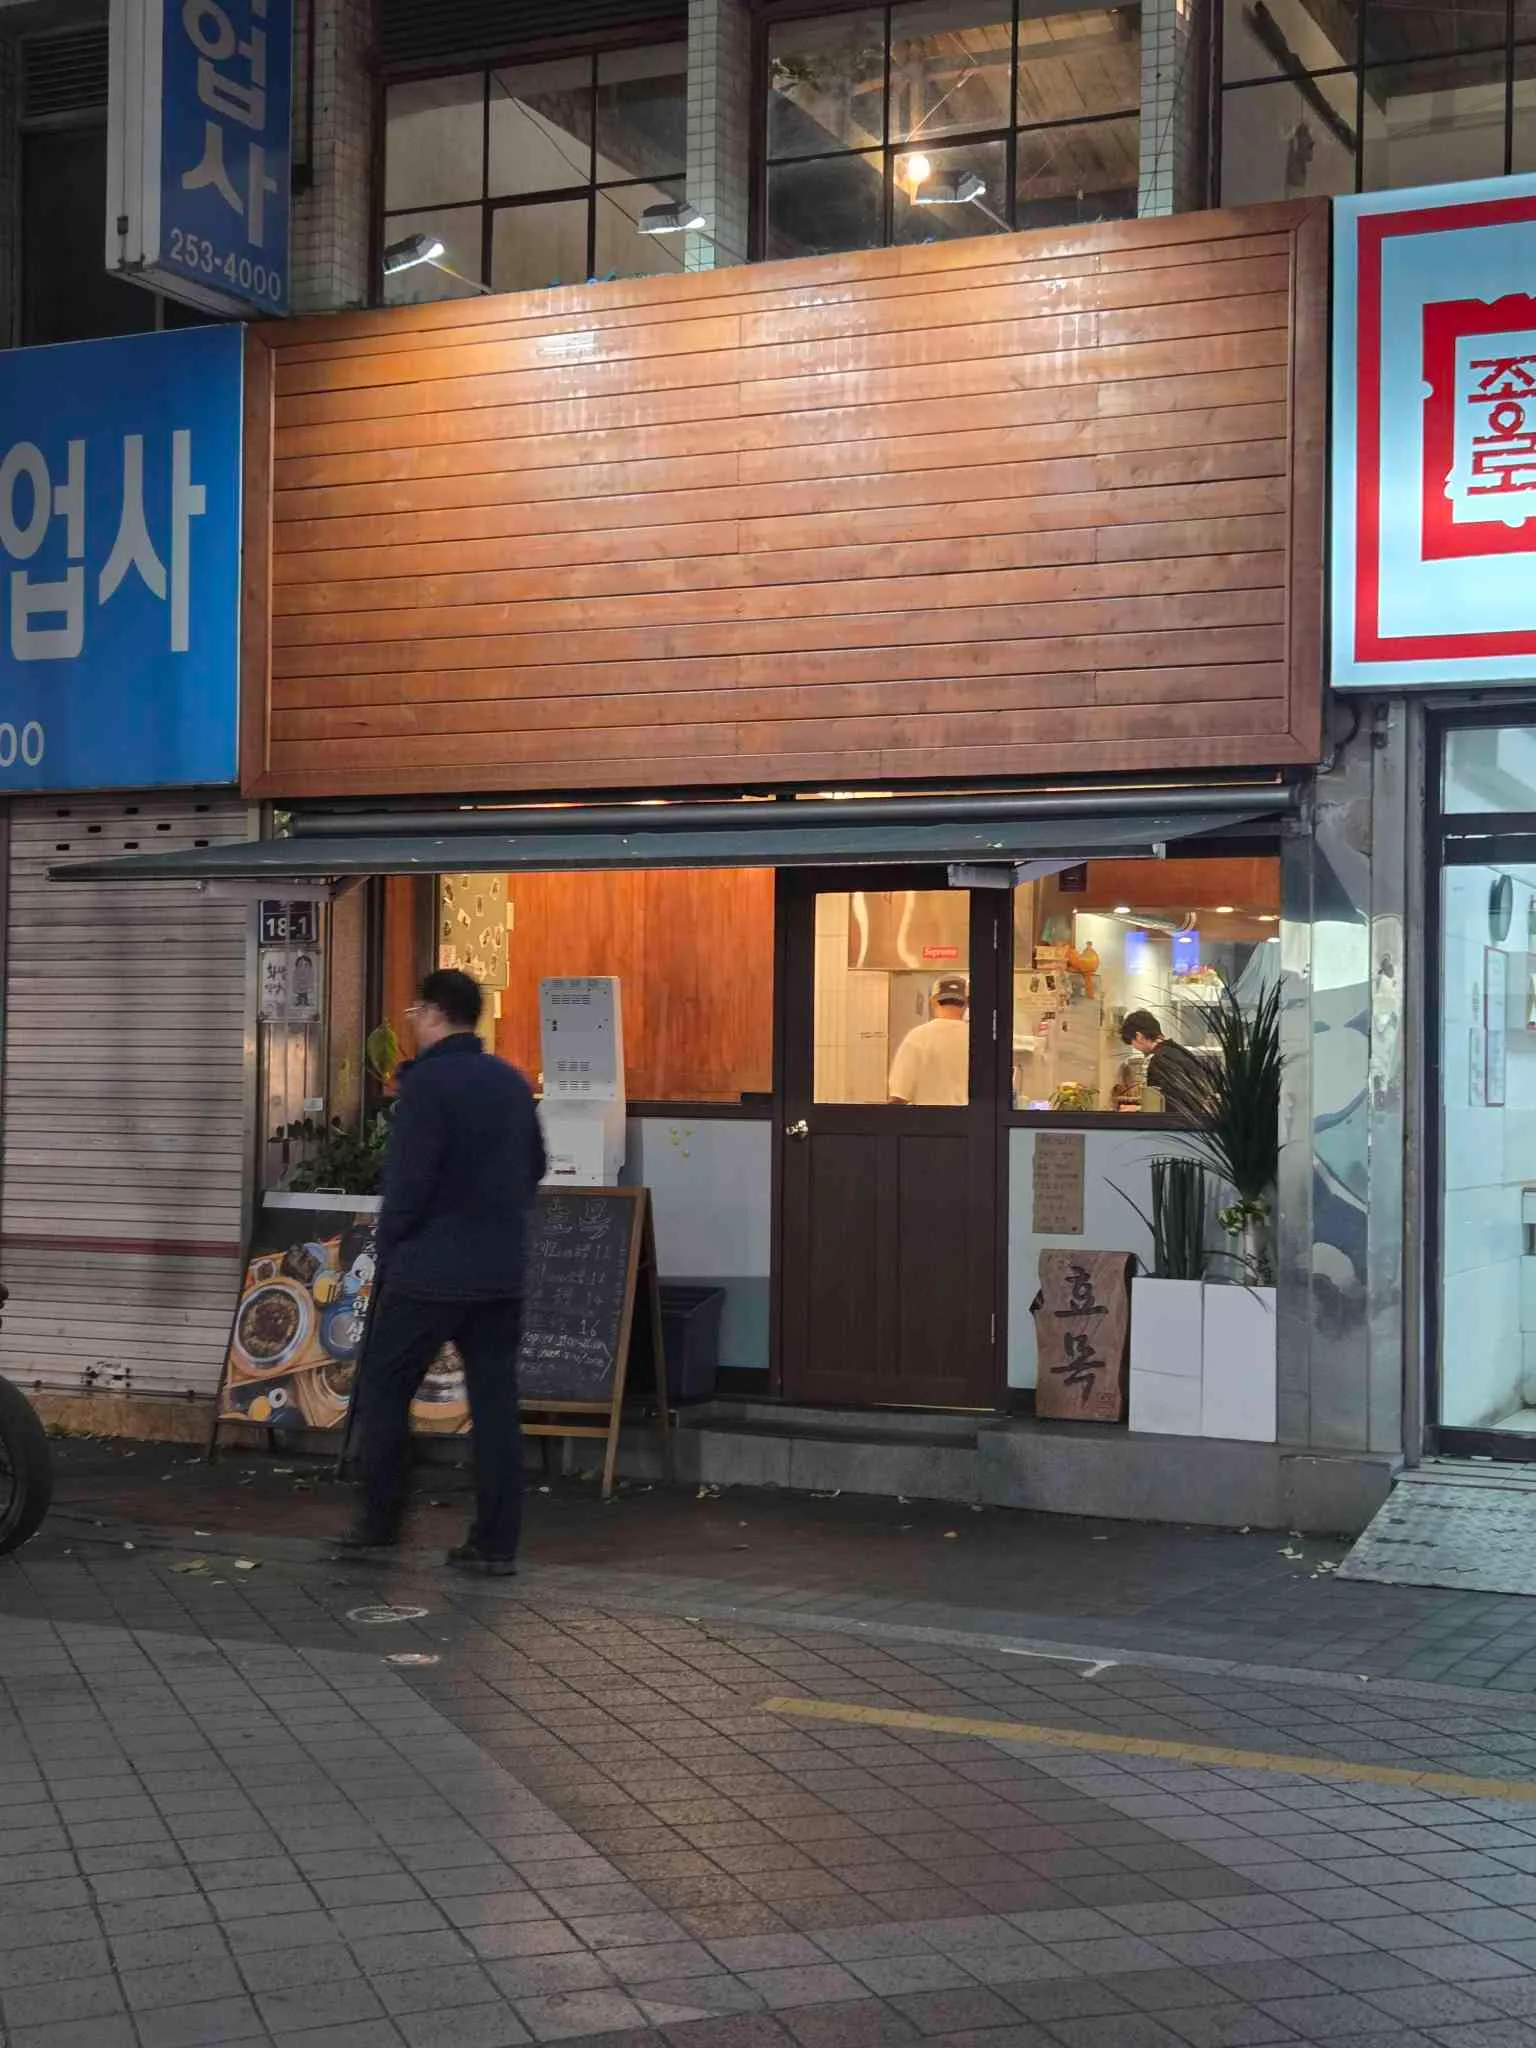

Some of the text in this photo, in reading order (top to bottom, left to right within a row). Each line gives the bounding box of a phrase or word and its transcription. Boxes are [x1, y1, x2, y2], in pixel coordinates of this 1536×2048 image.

[170, 228, 281, 299] 253-4000
[0, 430, 206, 661] 업사
[265, 916, 307, 937] 18-1
